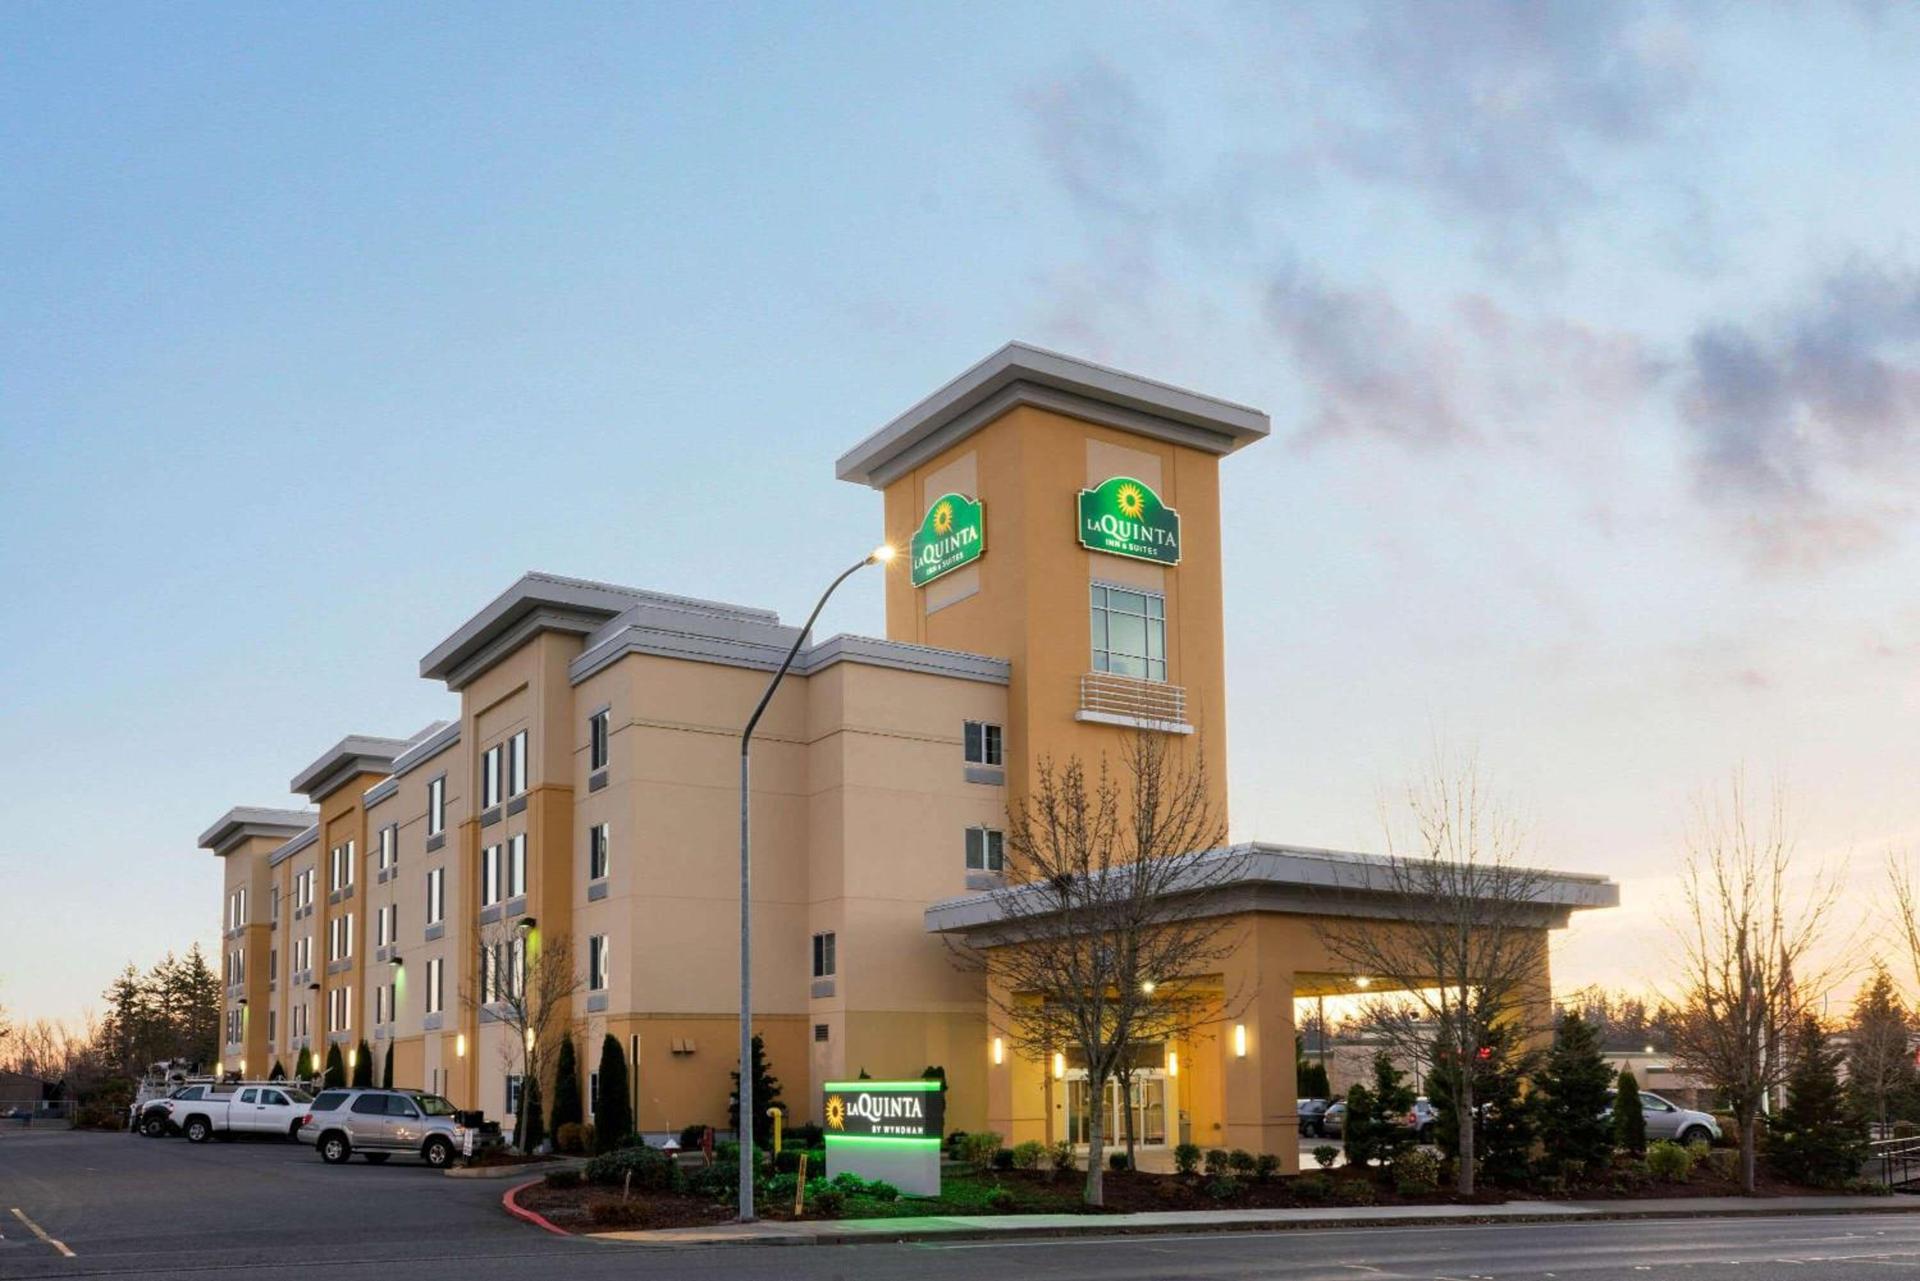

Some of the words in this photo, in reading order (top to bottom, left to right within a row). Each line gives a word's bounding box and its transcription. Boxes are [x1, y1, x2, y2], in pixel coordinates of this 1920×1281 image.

[1087, 518, 1101, 532] LA
[1101, 514, 1177, 547] QUINTA
[914, 557, 924, 570] LA
[923, 525, 978, 564] QUINTA
[1105, 538, 1121, 548] INN
[1129, 543, 1158, 556] SUITES
[847, 1102, 859, 1116] LA
[858, 1092, 923, 1122] QUINTA
[872, 1125, 881, 1134] BY
[883, 1125, 924, 1135] WYNDHAM
